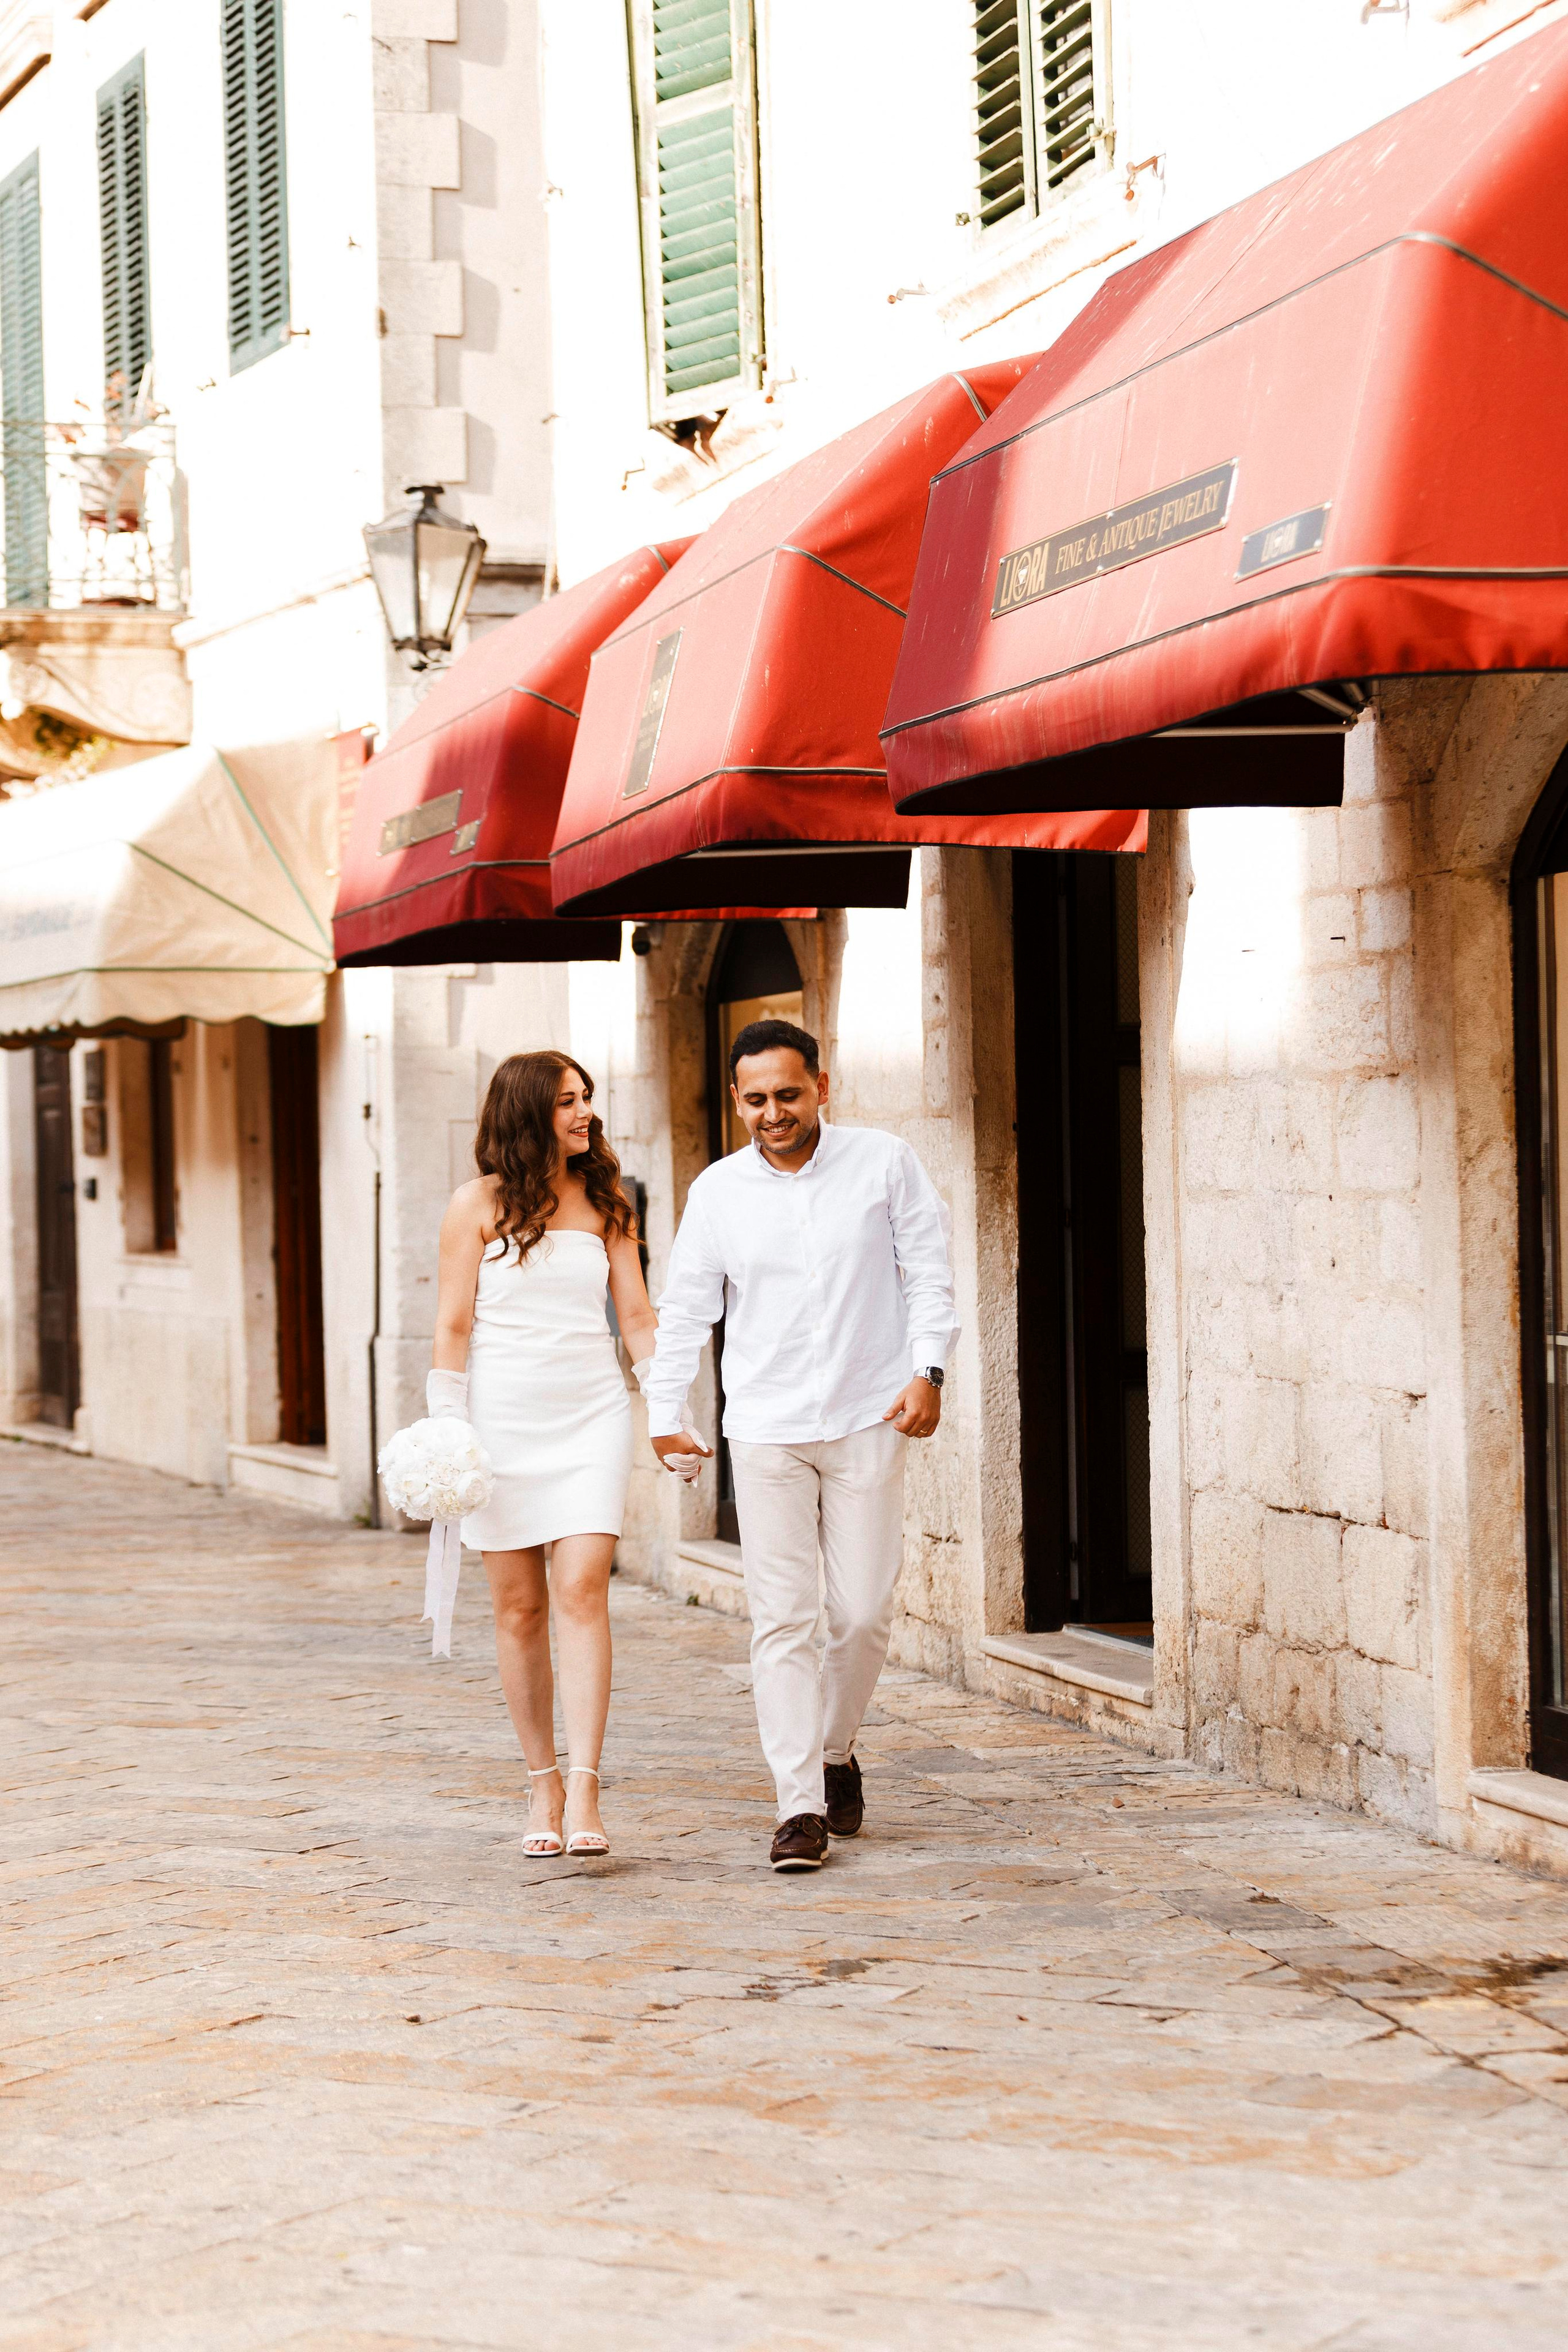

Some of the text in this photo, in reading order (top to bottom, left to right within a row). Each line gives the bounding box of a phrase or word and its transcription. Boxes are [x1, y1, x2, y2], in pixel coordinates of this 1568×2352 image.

[1000, 480, 1225, 608] LIORA FINE & ANTIQUE JEWELRY
